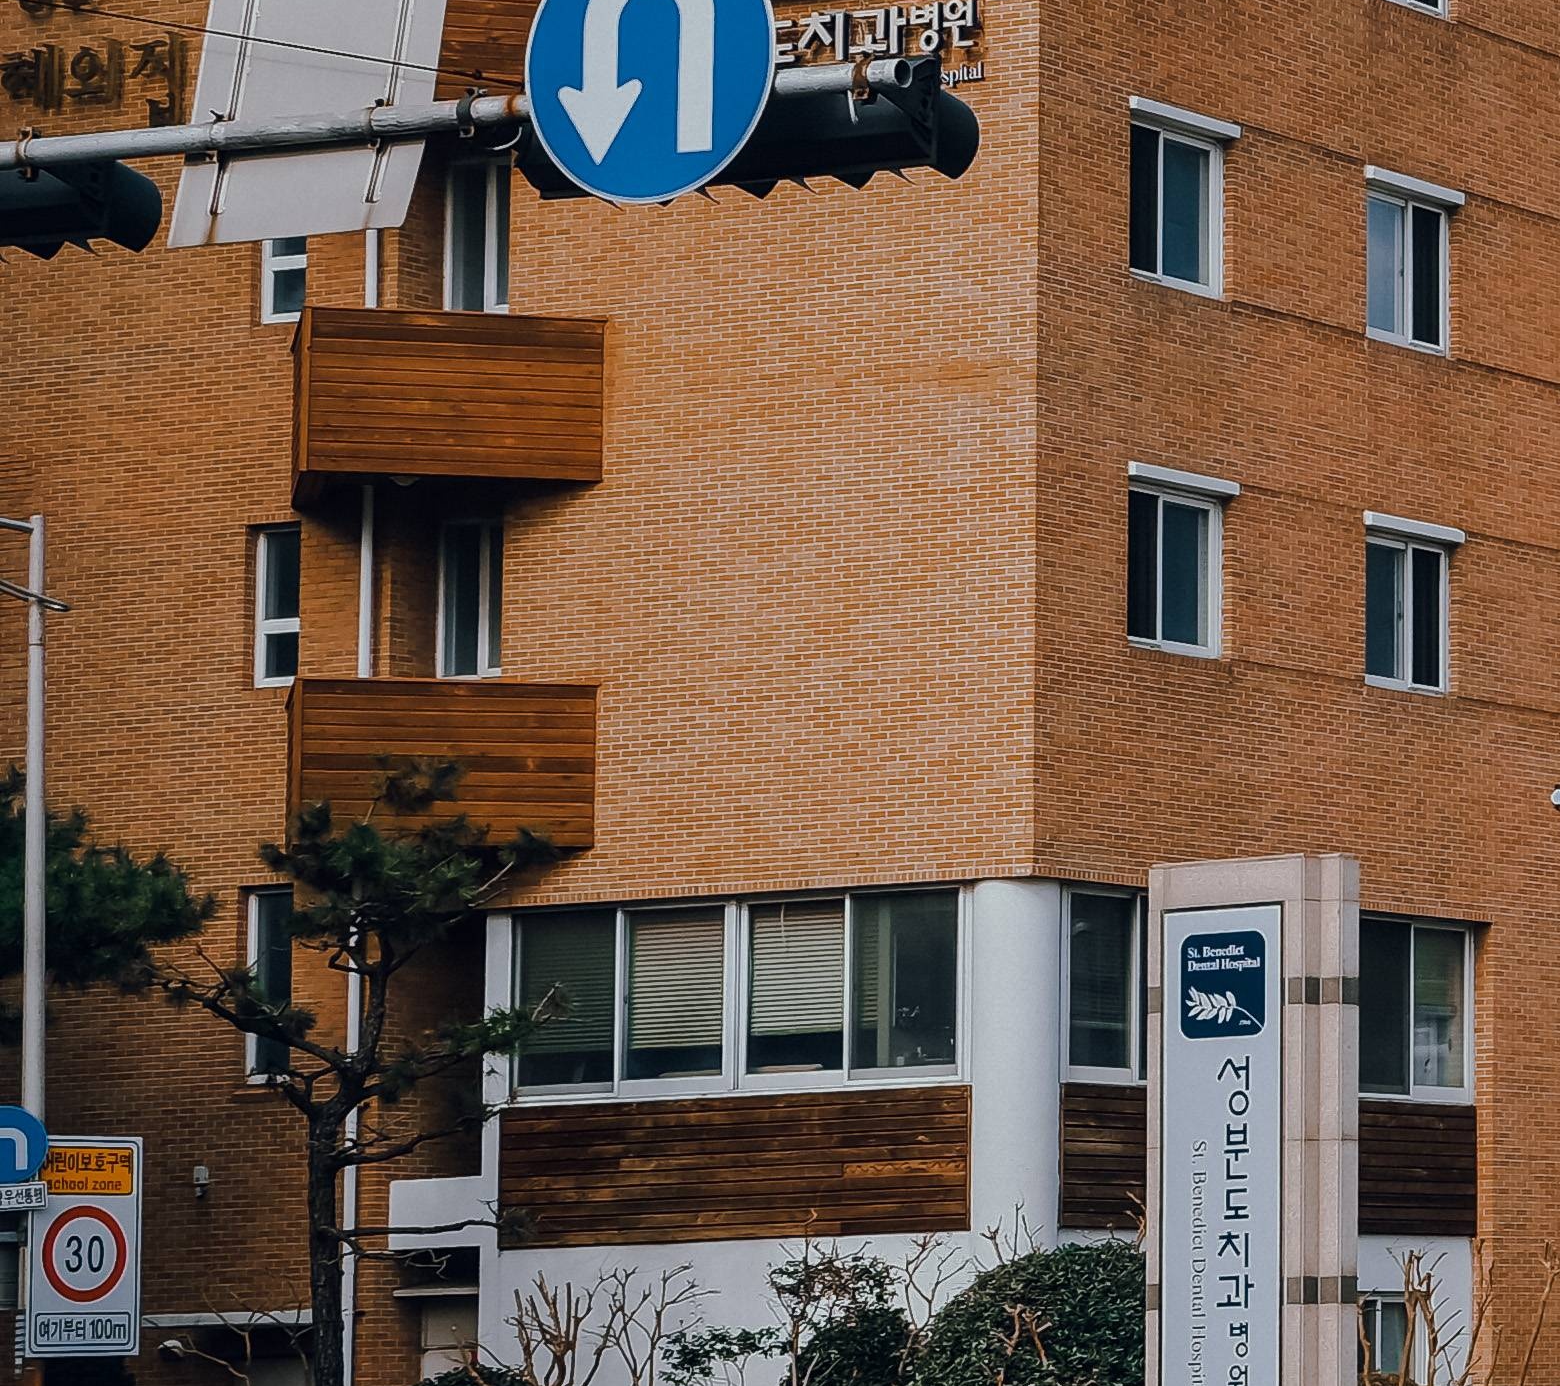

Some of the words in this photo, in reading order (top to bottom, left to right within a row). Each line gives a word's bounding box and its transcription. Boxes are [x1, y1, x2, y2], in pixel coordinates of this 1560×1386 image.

[941, 62, 983, 89] spital
[1203, 944, 1244, 958] Benedict
[1221, 956, 1261, 972] Hospital
[91, 1179, 122, 1191] zone
[1191, 1170, 1208, 1252] Benedict
[64, 1235, 105, 1273] 30
[1191, 1257, 1207, 1318] Dental
[38, 1319, 86, 1341] 여기부터
[89, 1317, 127, 1340] 100m
